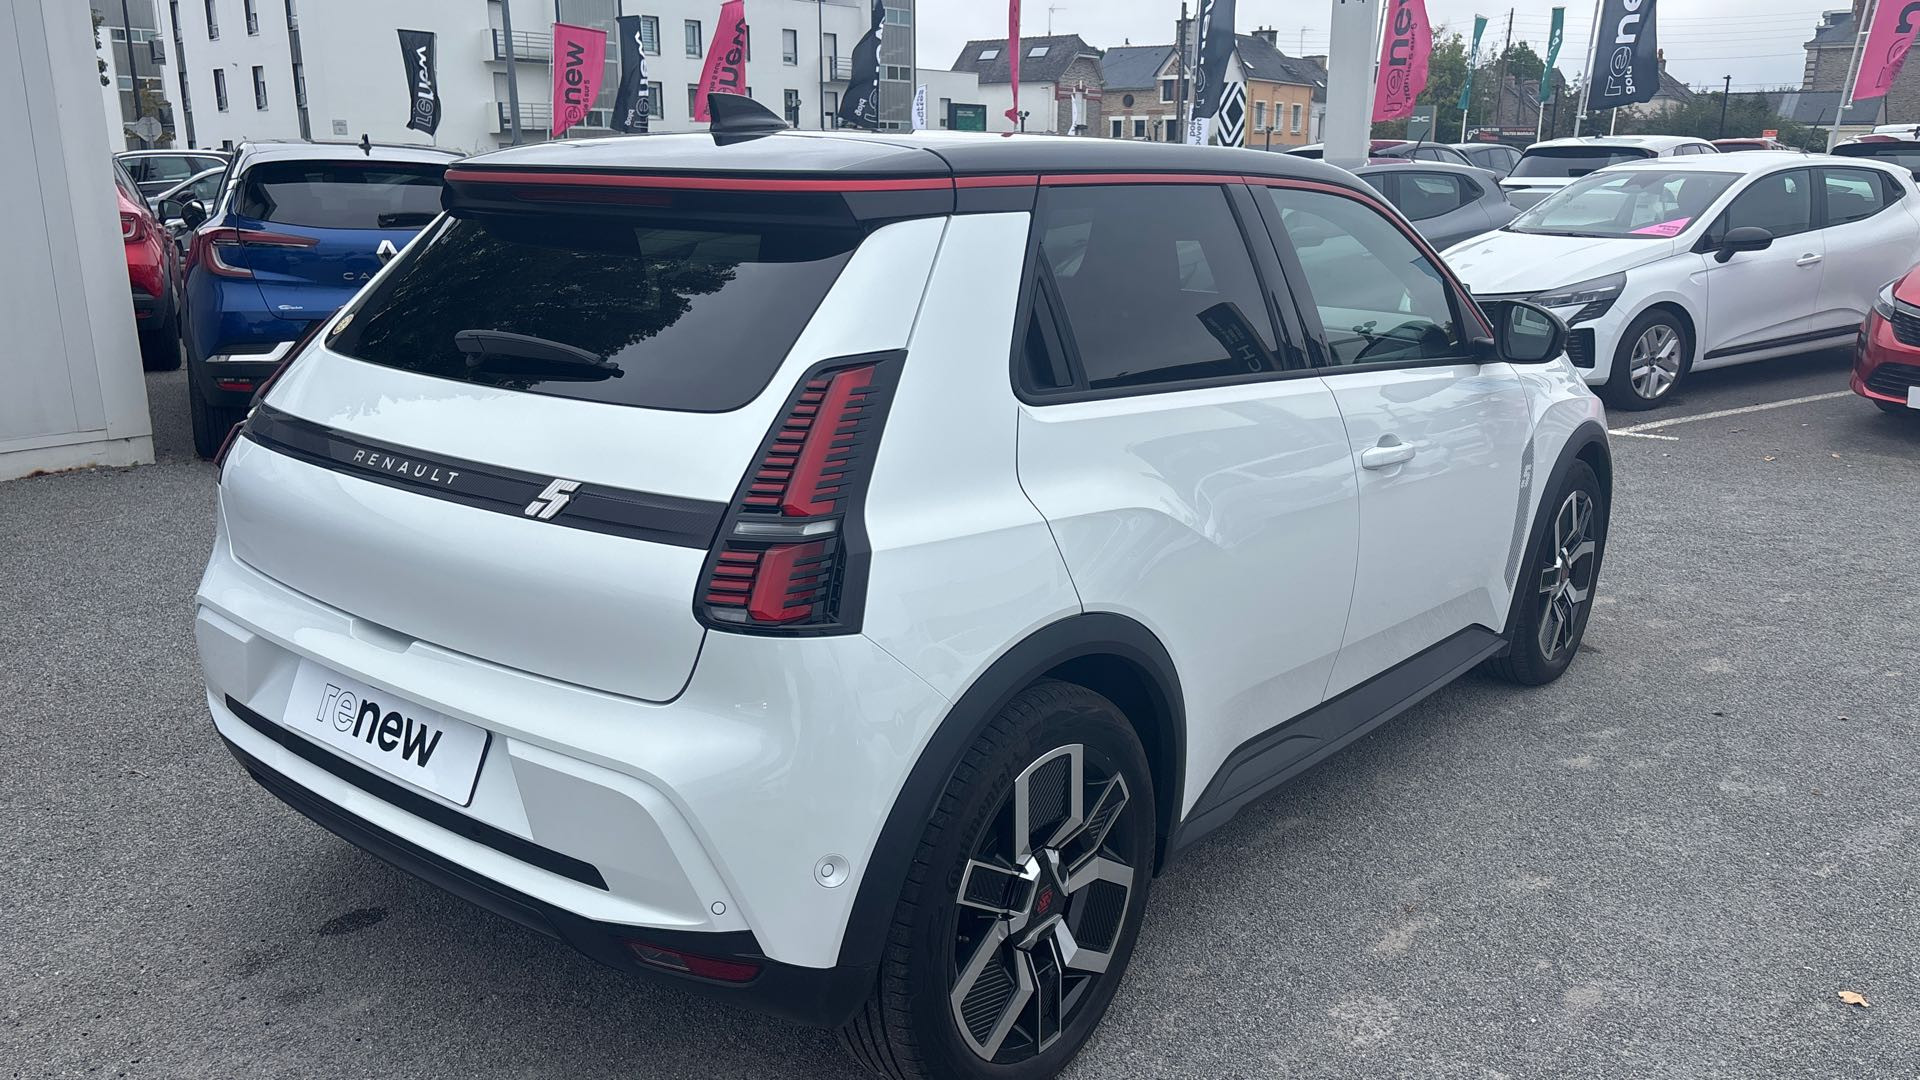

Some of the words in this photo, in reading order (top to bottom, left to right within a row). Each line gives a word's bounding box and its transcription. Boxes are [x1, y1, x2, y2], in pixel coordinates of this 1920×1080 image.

[1383, 0, 1412, 113] rene
[343, 272, 374, 280] CA
[353, 450, 459, 485] RENAULT
[316, 683, 444, 768] renew
